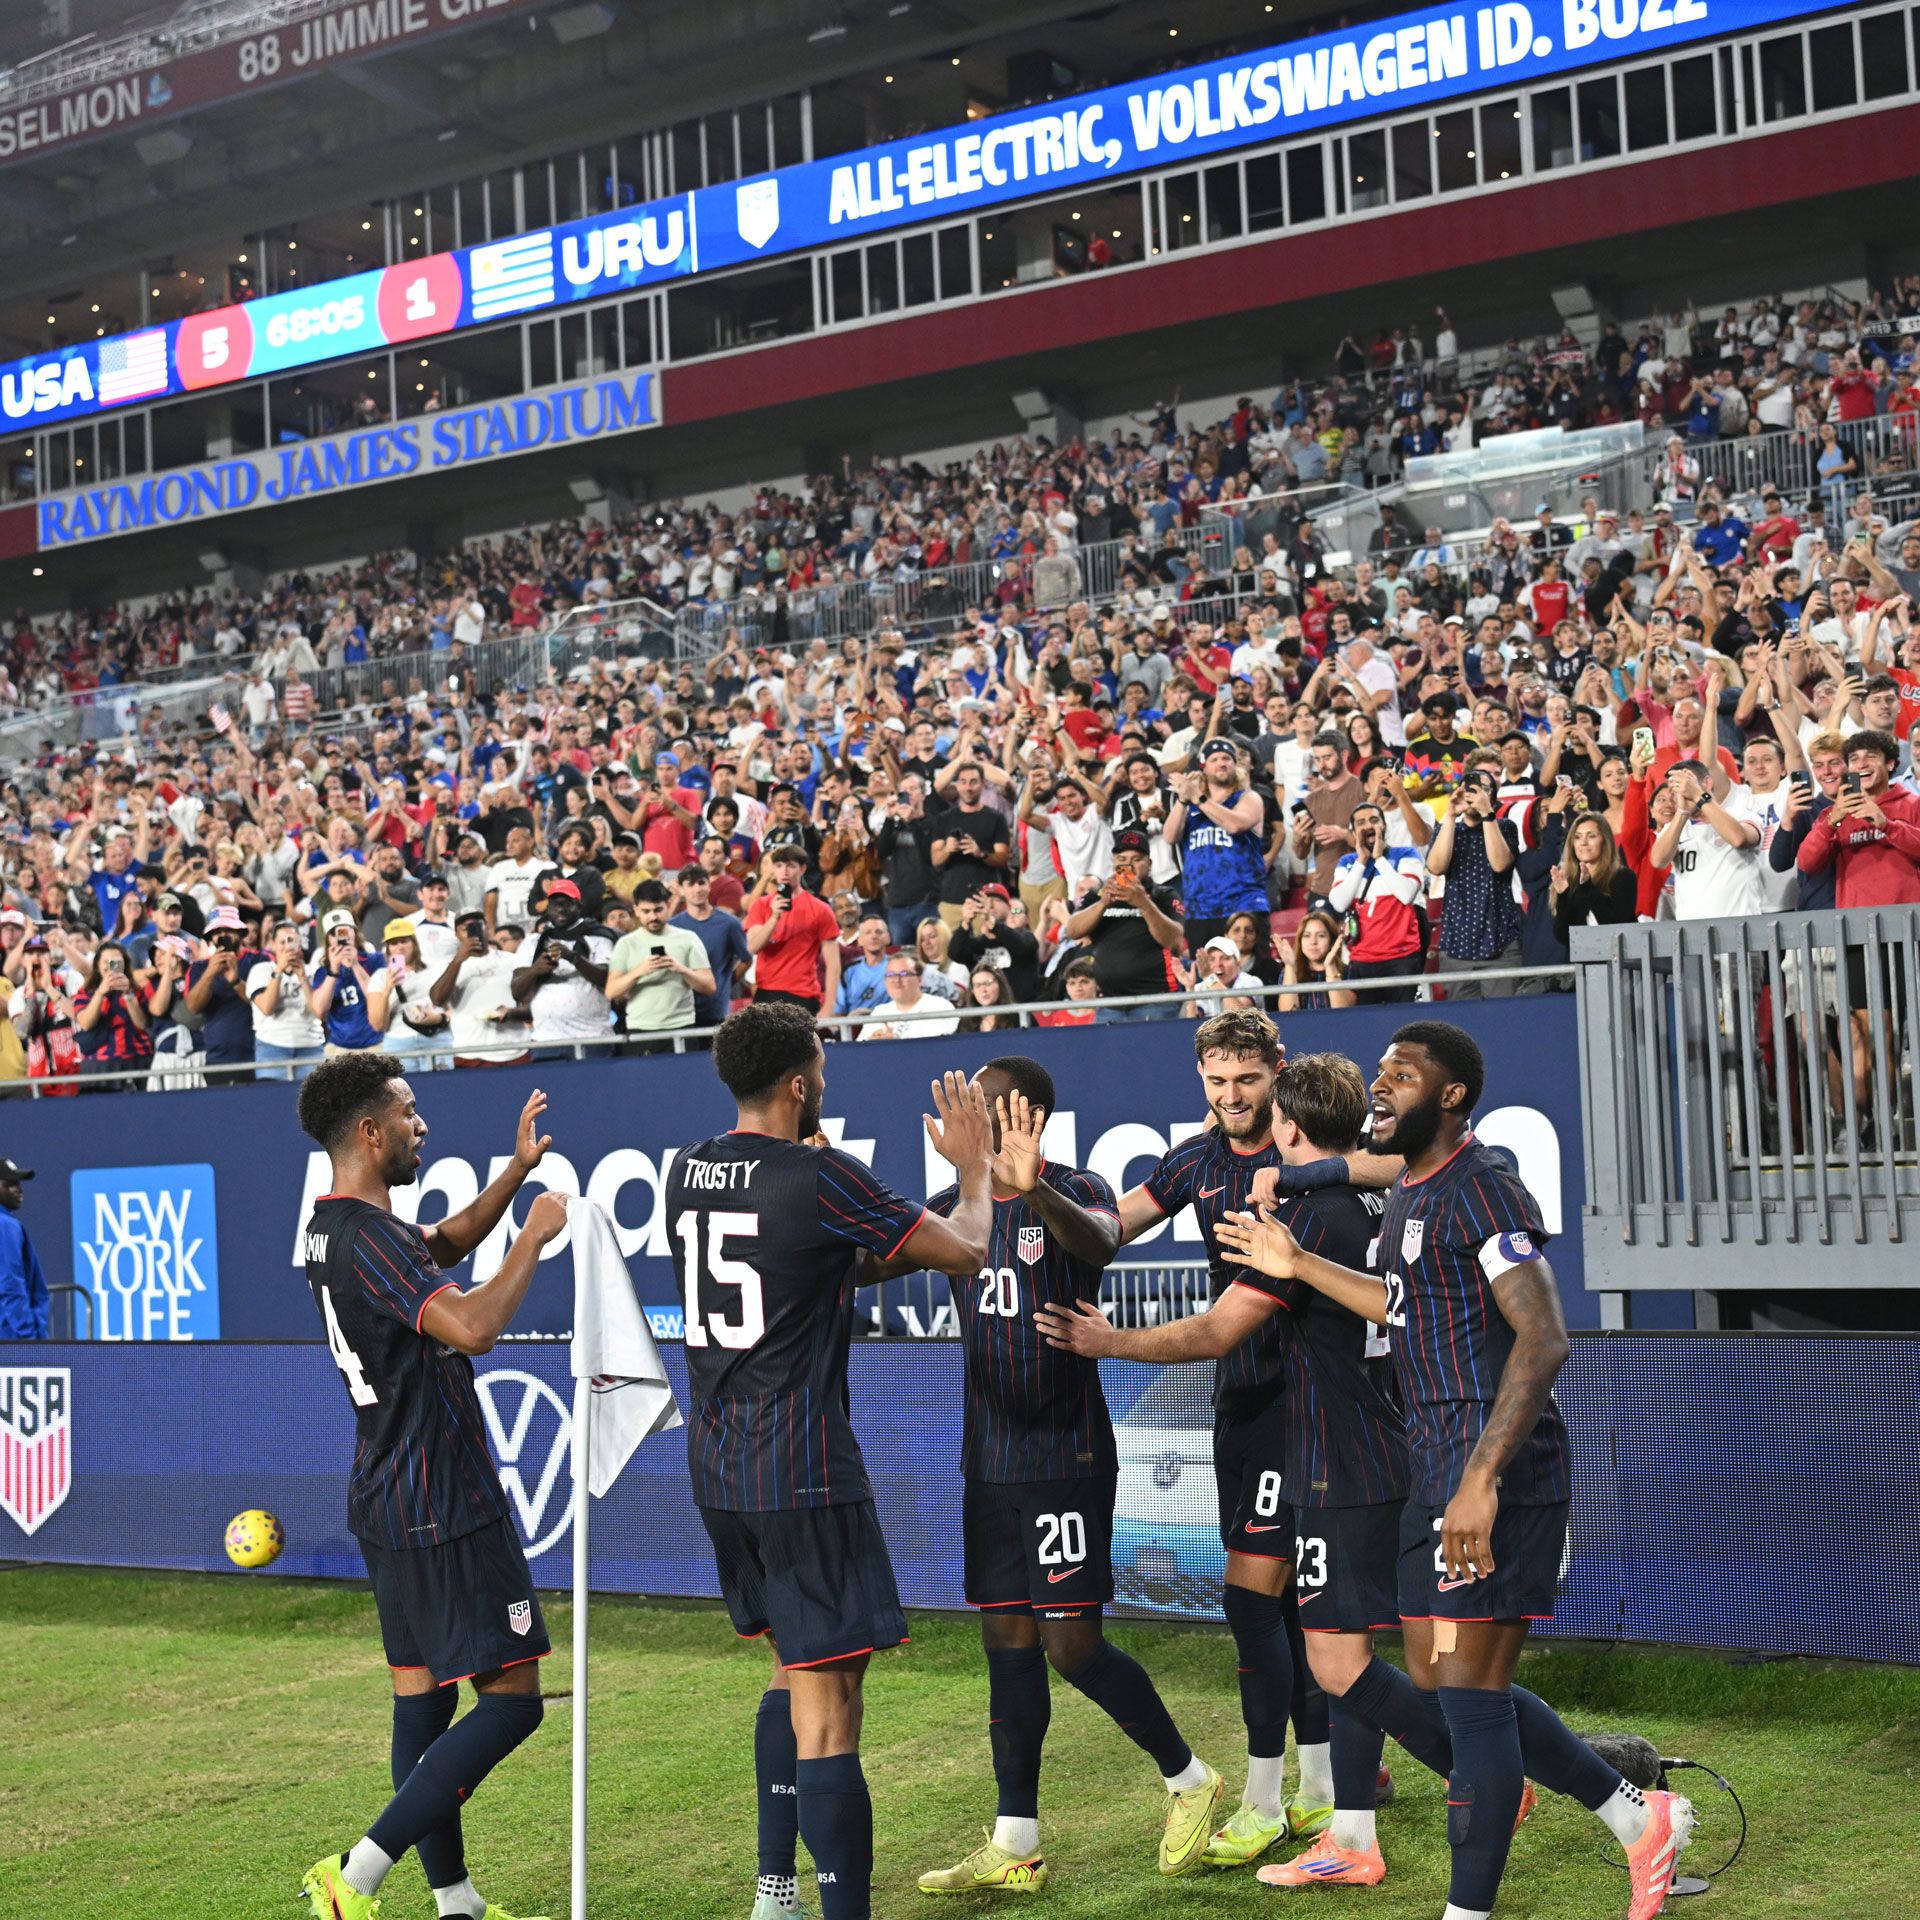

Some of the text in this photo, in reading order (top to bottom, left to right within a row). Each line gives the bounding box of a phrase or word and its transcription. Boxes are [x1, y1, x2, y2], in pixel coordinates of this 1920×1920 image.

[239, 0, 430, 81] 88 JIMMIE
[0, 78, 141, 156] SELMON
[828, 105, 1123, 225] ALL-ELECTRIC,
[1127, 13, 1468, 152] VOLKSWAGEN
[1477, 11, 1553, 70] ID.
[561, 211, 686, 285] URU
[265, 296, 365, 348] 68:05
[405, 278, 436, 321] 1
[201, 327, 230, 369] 5
[2, 357, 94, 417] USA
[39, 373, 656, 547] RAYMOND JAMES STADIUM
[1189, 827, 1233, 850] STATES
[341, 985, 359, 1007] 13
[683, 1158, 761, 1190] TRUSTY
[94, 1189, 192, 1246] NEW
[1020, 1228, 1042, 1243] USA
[79, 1238, 207, 1296] YORK
[676, 1210, 765, 1350] 15
[977, 1267, 1019, 1317] 20
[93, 1288, 194, 1341] LIFE
[0, 1376, 65, 1438] USA
[1254, 1470, 1281, 1517] 8
[1035, 1511, 1087, 1565] 20
[509, 1602, 529, 1617] USA
[771, 1783, 797, 1795] USA
[817, 1871, 837, 1883] USA
